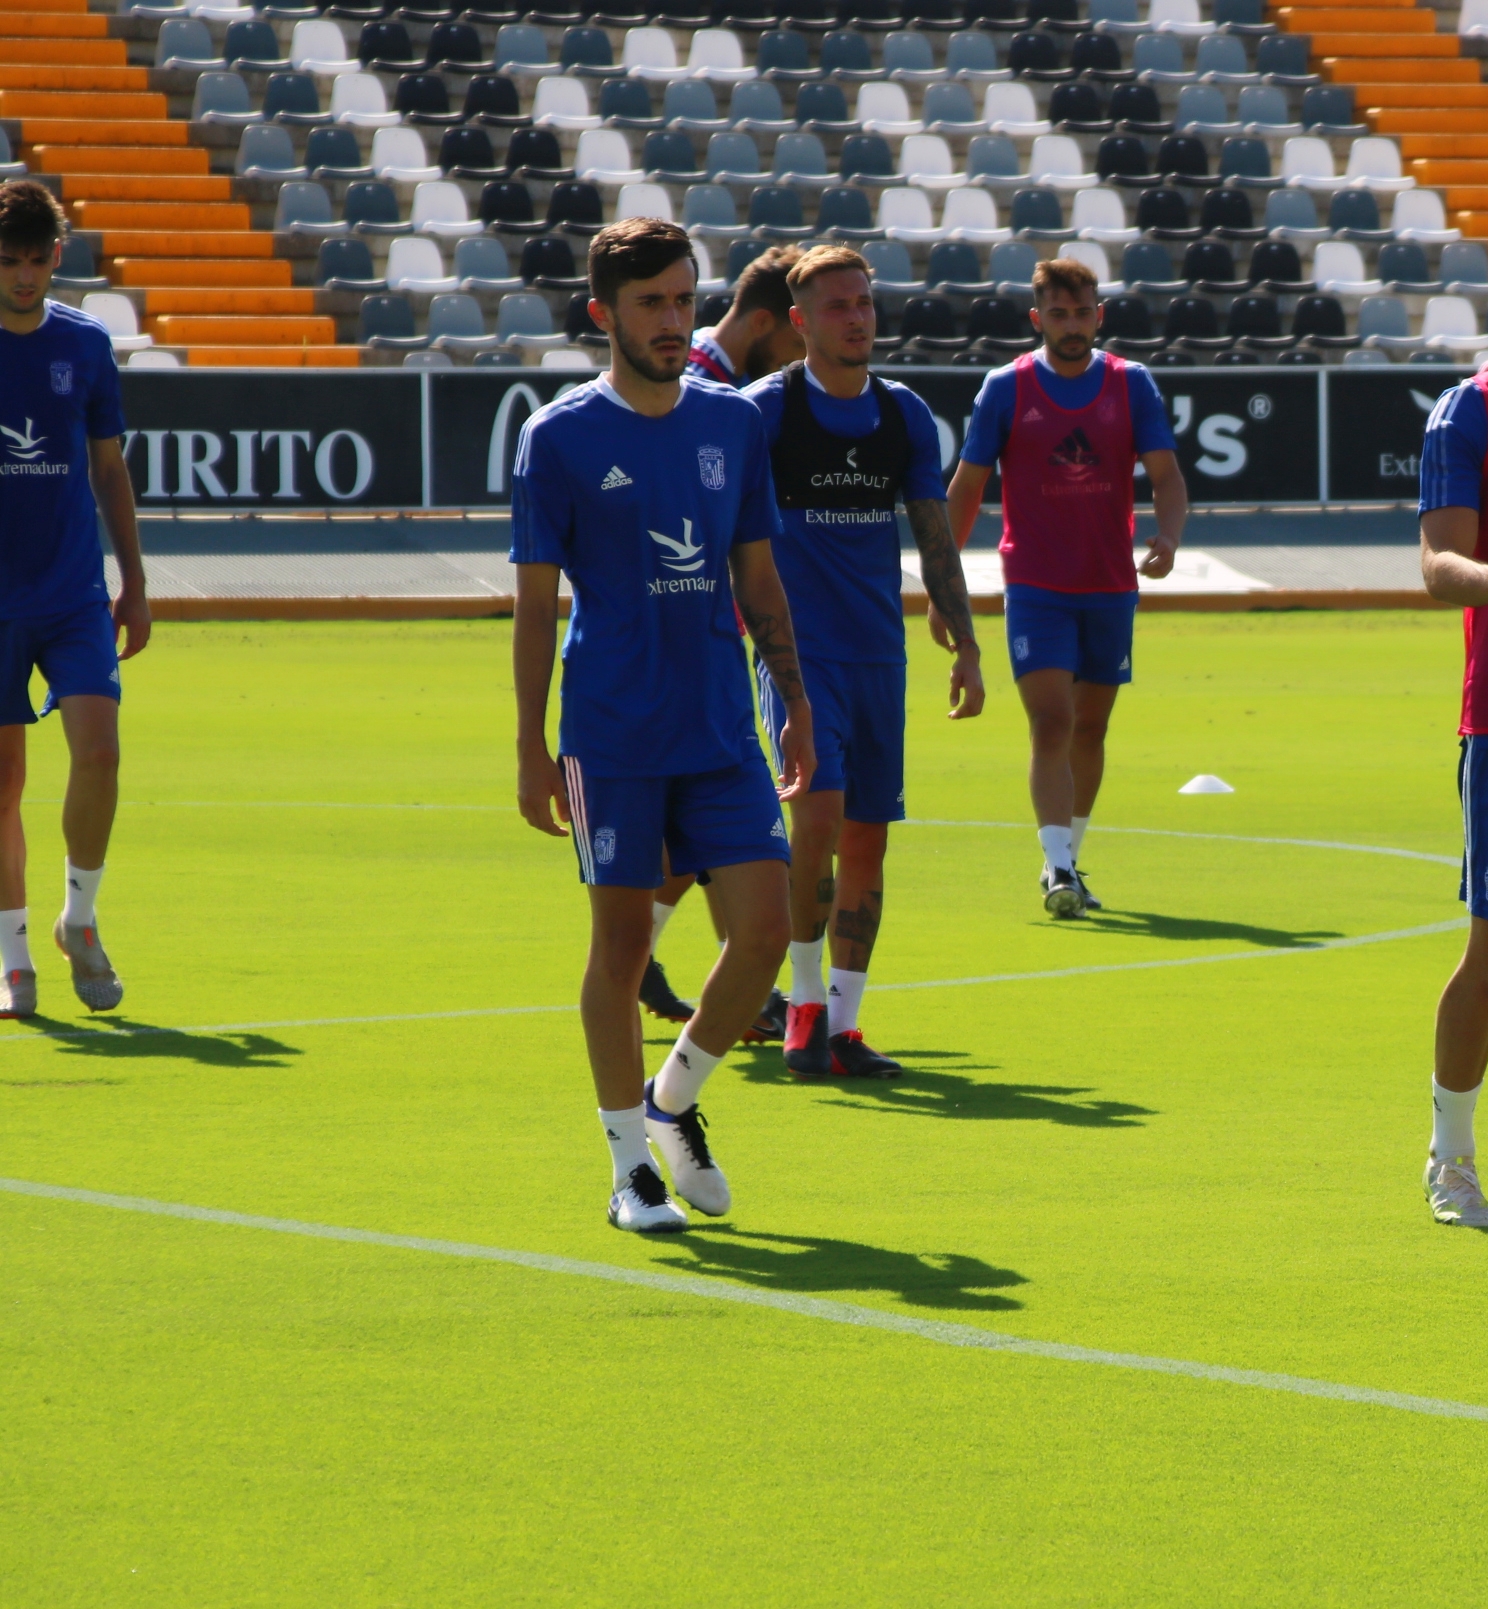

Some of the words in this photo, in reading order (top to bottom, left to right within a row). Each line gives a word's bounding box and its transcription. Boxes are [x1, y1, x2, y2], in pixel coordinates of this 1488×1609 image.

[1379, 452, 1421, 477] Ext
[601, 476, 633, 491] adidas
[810, 473, 890, 489] CATAPULT
[805, 508, 892, 524] Extremadura
